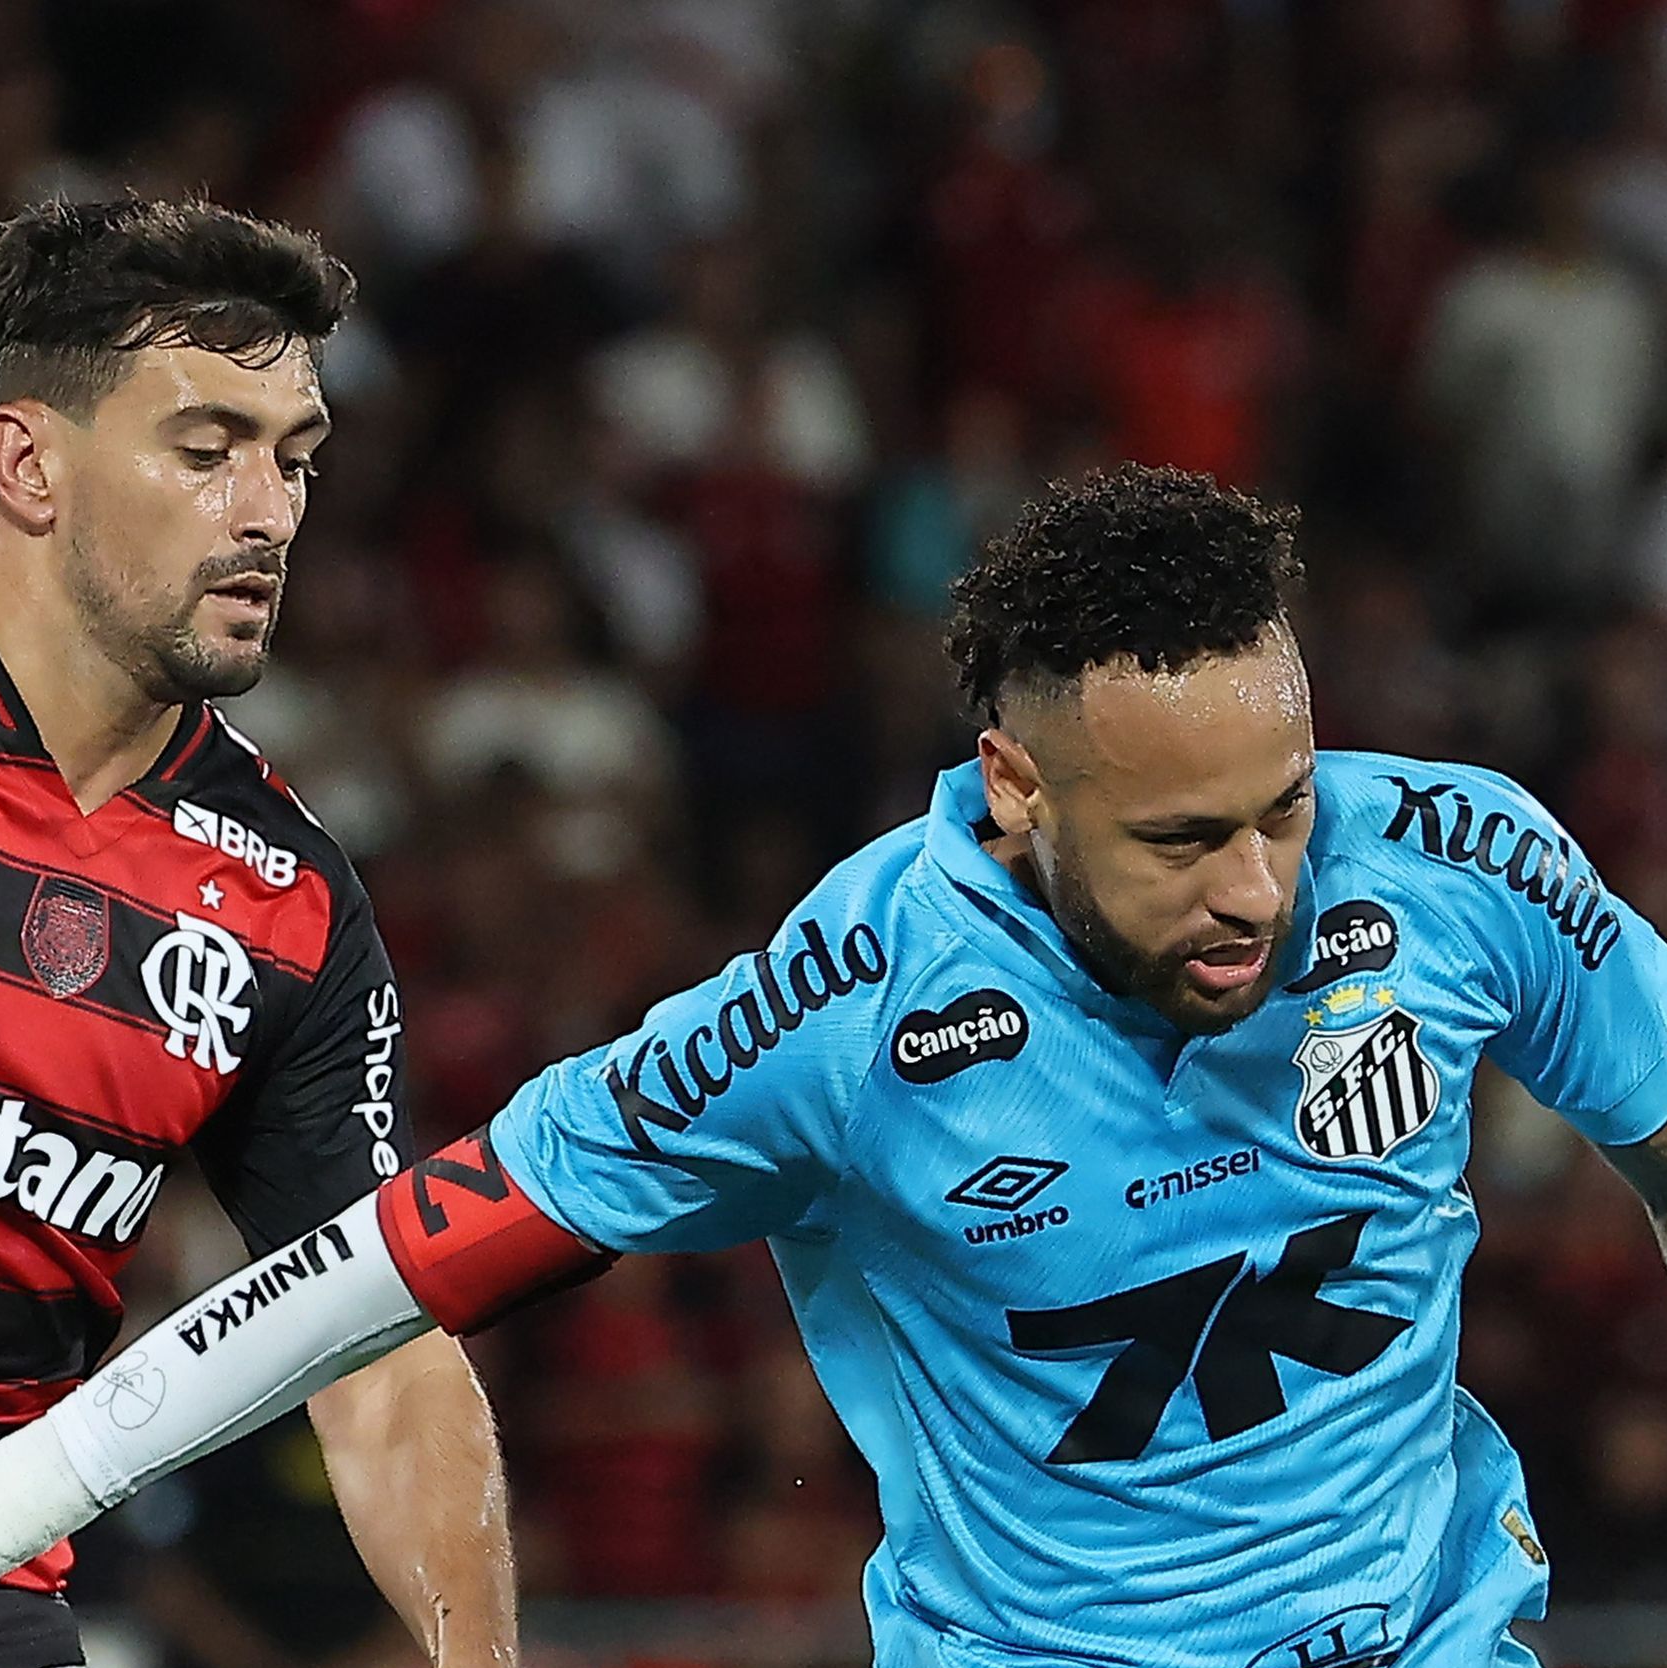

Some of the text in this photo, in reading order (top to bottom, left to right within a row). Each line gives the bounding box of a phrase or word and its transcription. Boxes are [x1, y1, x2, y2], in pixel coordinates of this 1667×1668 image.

[219, 814, 298, 888] BRB
[1372, 775, 1622, 972] Kicaldo
[1311, 918, 1392, 966] nção
[351, 981, 403, 1184] Shope
[590, 917, 888, 1154] Kicaldo
[897, 1005, 1022, 1066] Canção
[963, 1203, 1070, 1246] umbro
[178, 1223, 355, 1357] UNIKKA
